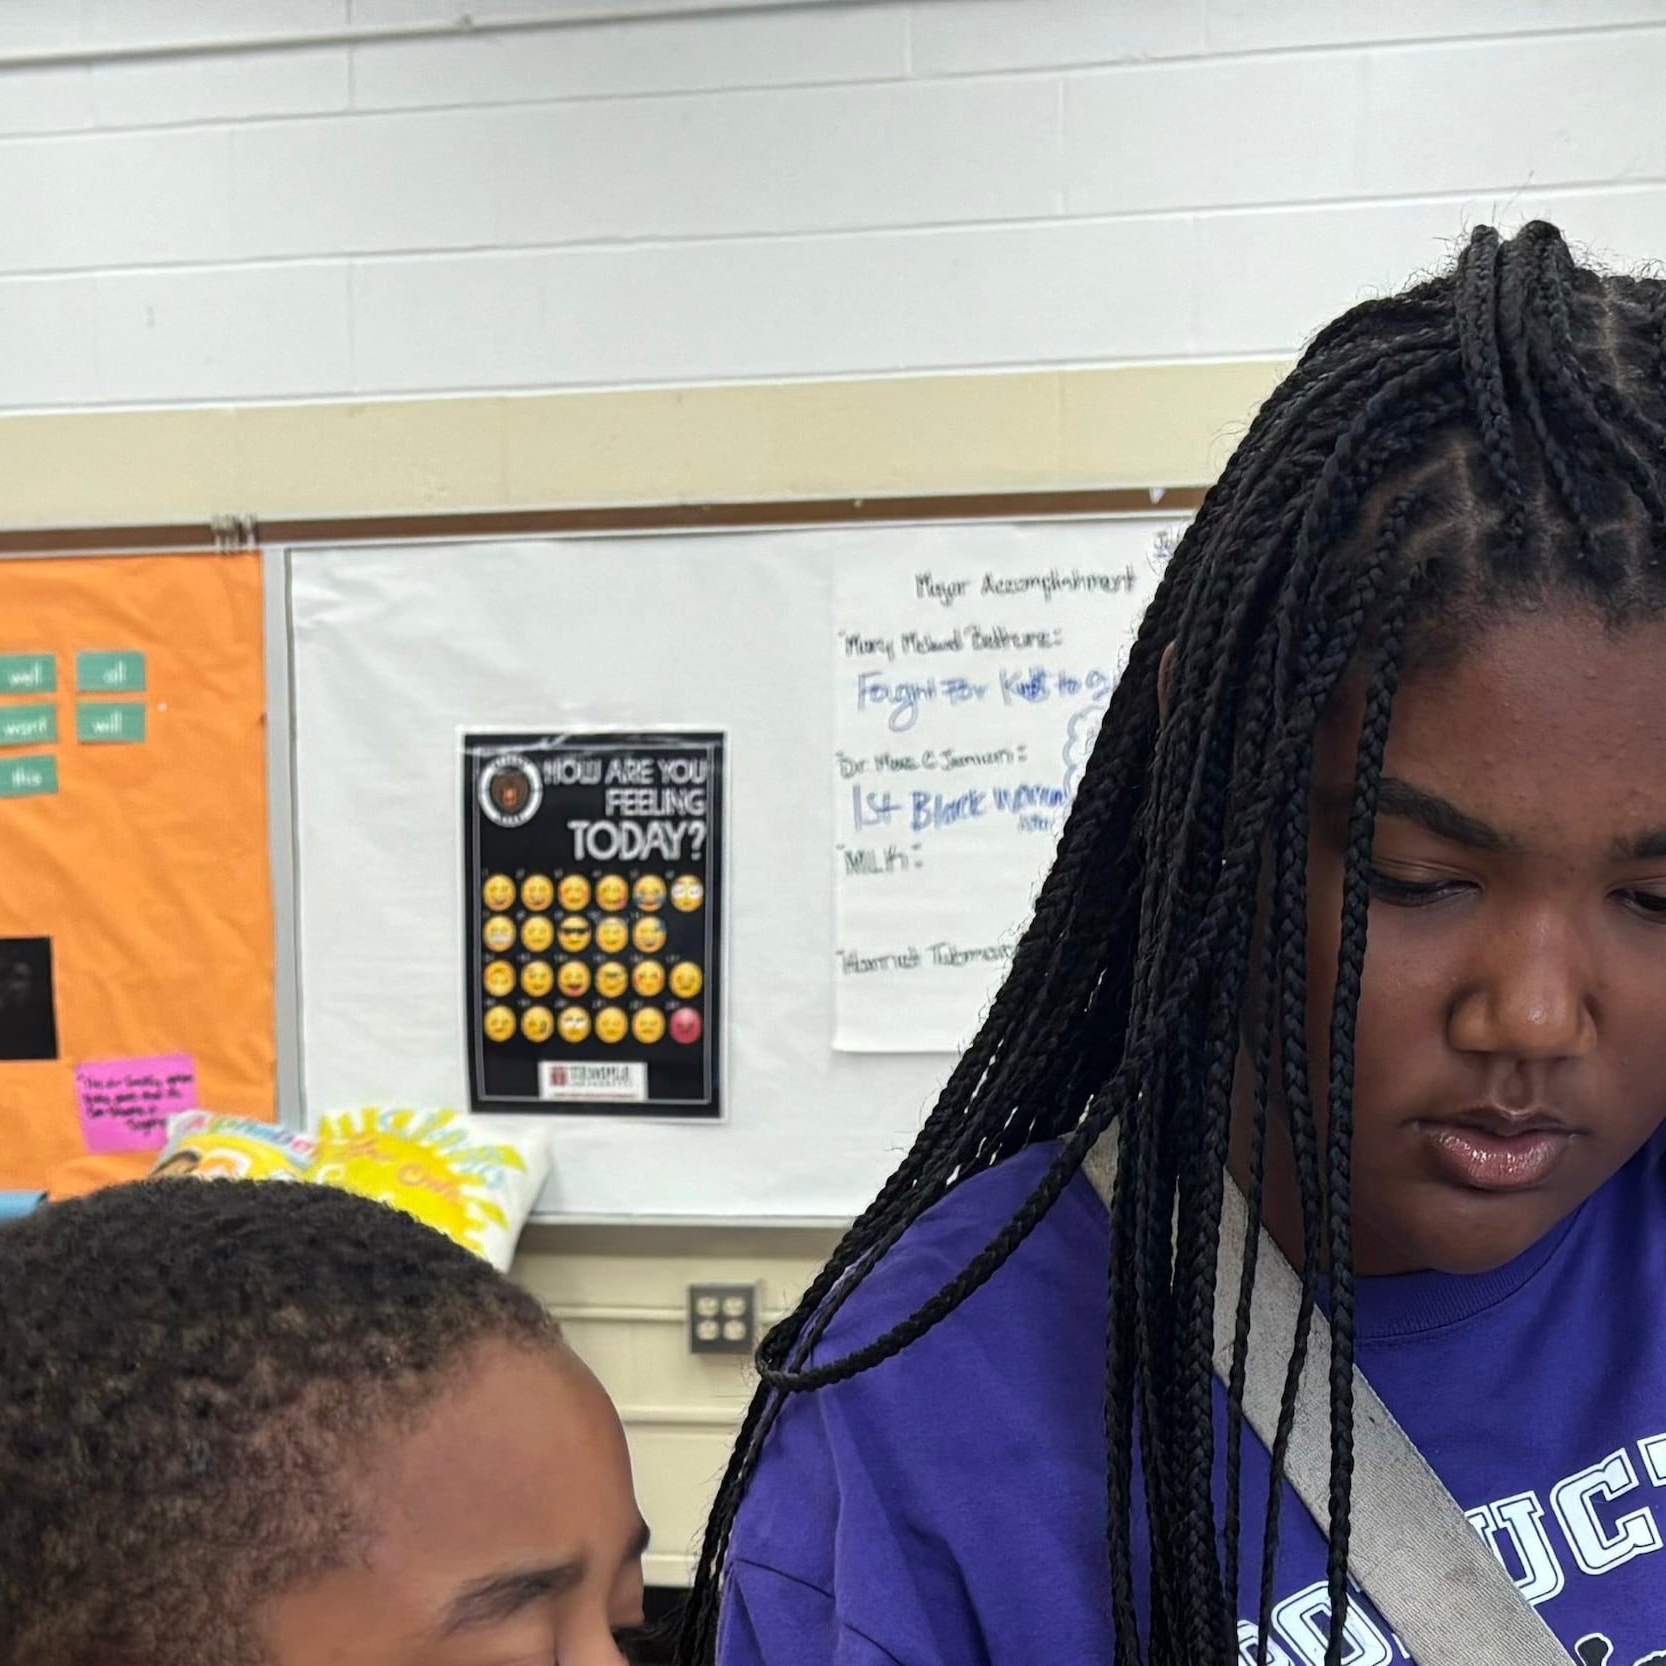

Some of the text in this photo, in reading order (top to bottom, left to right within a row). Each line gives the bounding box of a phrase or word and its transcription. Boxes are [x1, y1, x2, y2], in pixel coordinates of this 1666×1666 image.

[915, 572, 969, 607] Major
[91, 711, 123, 735] will
[543, 759, 603, 785] HOW
[604, 760, 654, 785] ARE
[656, 759, 708, 784] YOU
[605, 788, 706, 817] FEELING
[567, 820, 707, 861] TODAY?
